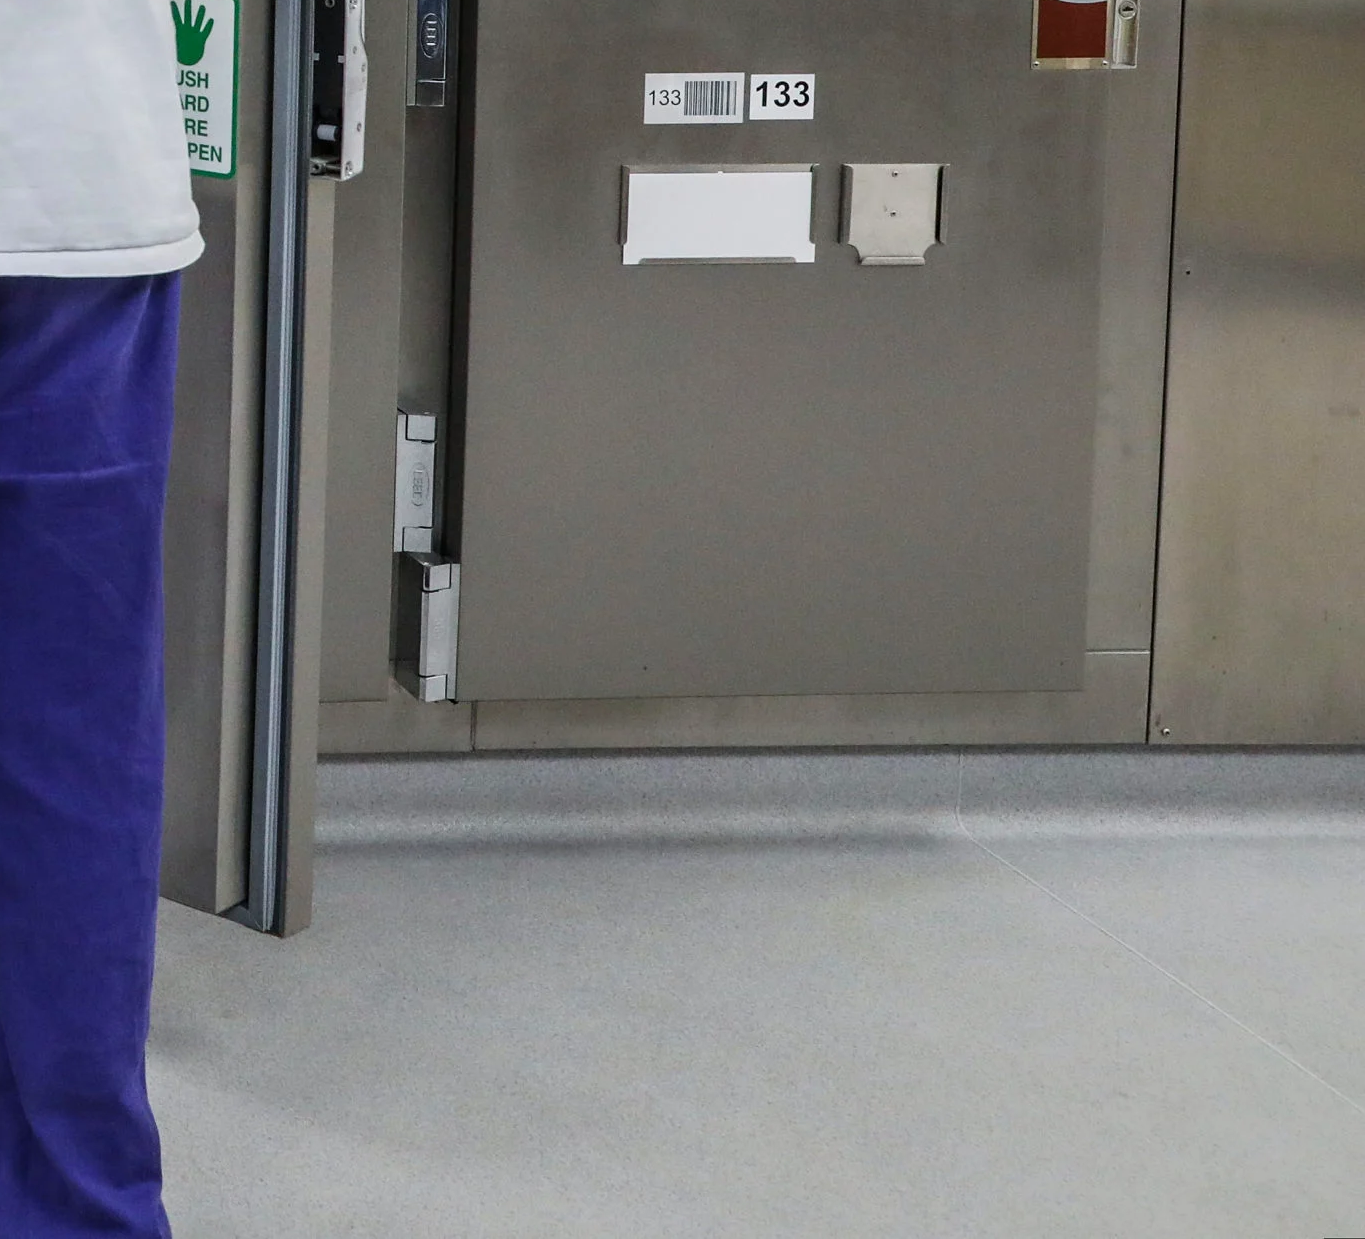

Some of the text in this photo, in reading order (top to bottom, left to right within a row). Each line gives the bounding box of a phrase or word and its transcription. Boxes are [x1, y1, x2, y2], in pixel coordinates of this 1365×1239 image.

[177, 70, 209, 89] USH
[648, 88, 681, 106] 133
[756, 80, 810, 107] 133
[184, 117, 208, 137] RE
[188, 143, 222, 163] PEN
